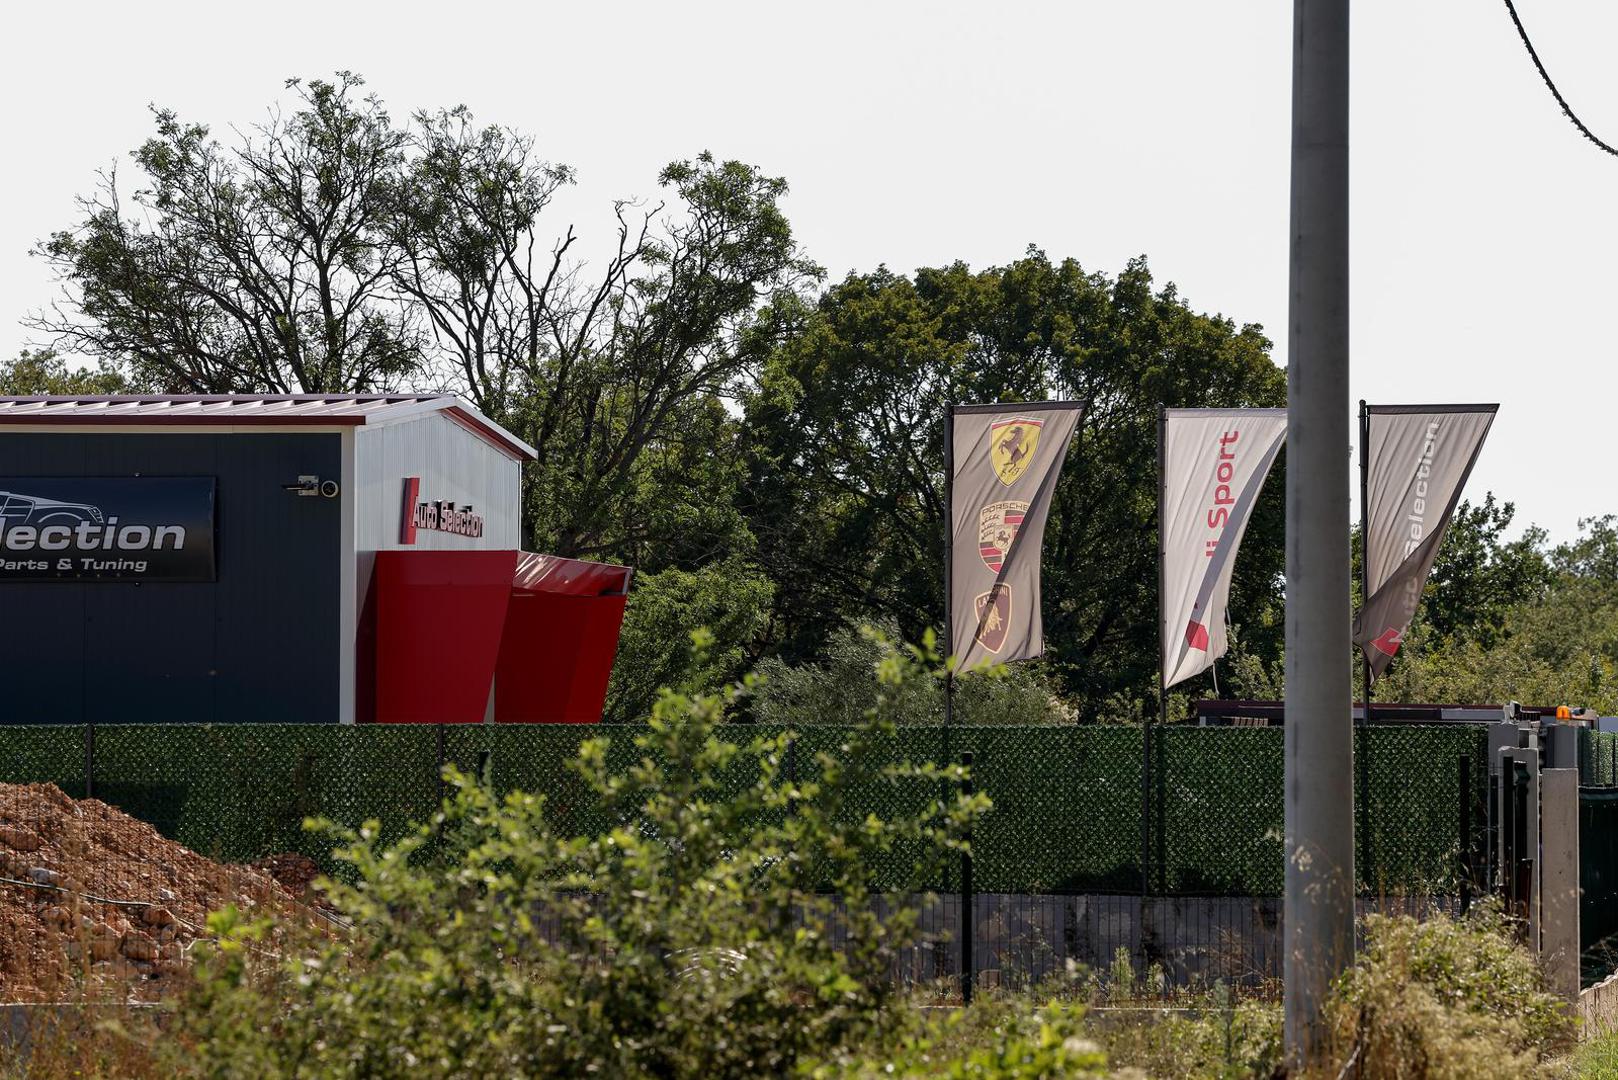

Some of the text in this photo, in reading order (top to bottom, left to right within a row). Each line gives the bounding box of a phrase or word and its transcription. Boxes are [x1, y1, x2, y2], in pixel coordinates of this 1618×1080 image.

[1206, 430, 1240, 529] Sport
[411, 496, 485, 537] Auto Selection
[56, 558, 73, 571] &
[80, 558, 148, 573] Tuning
